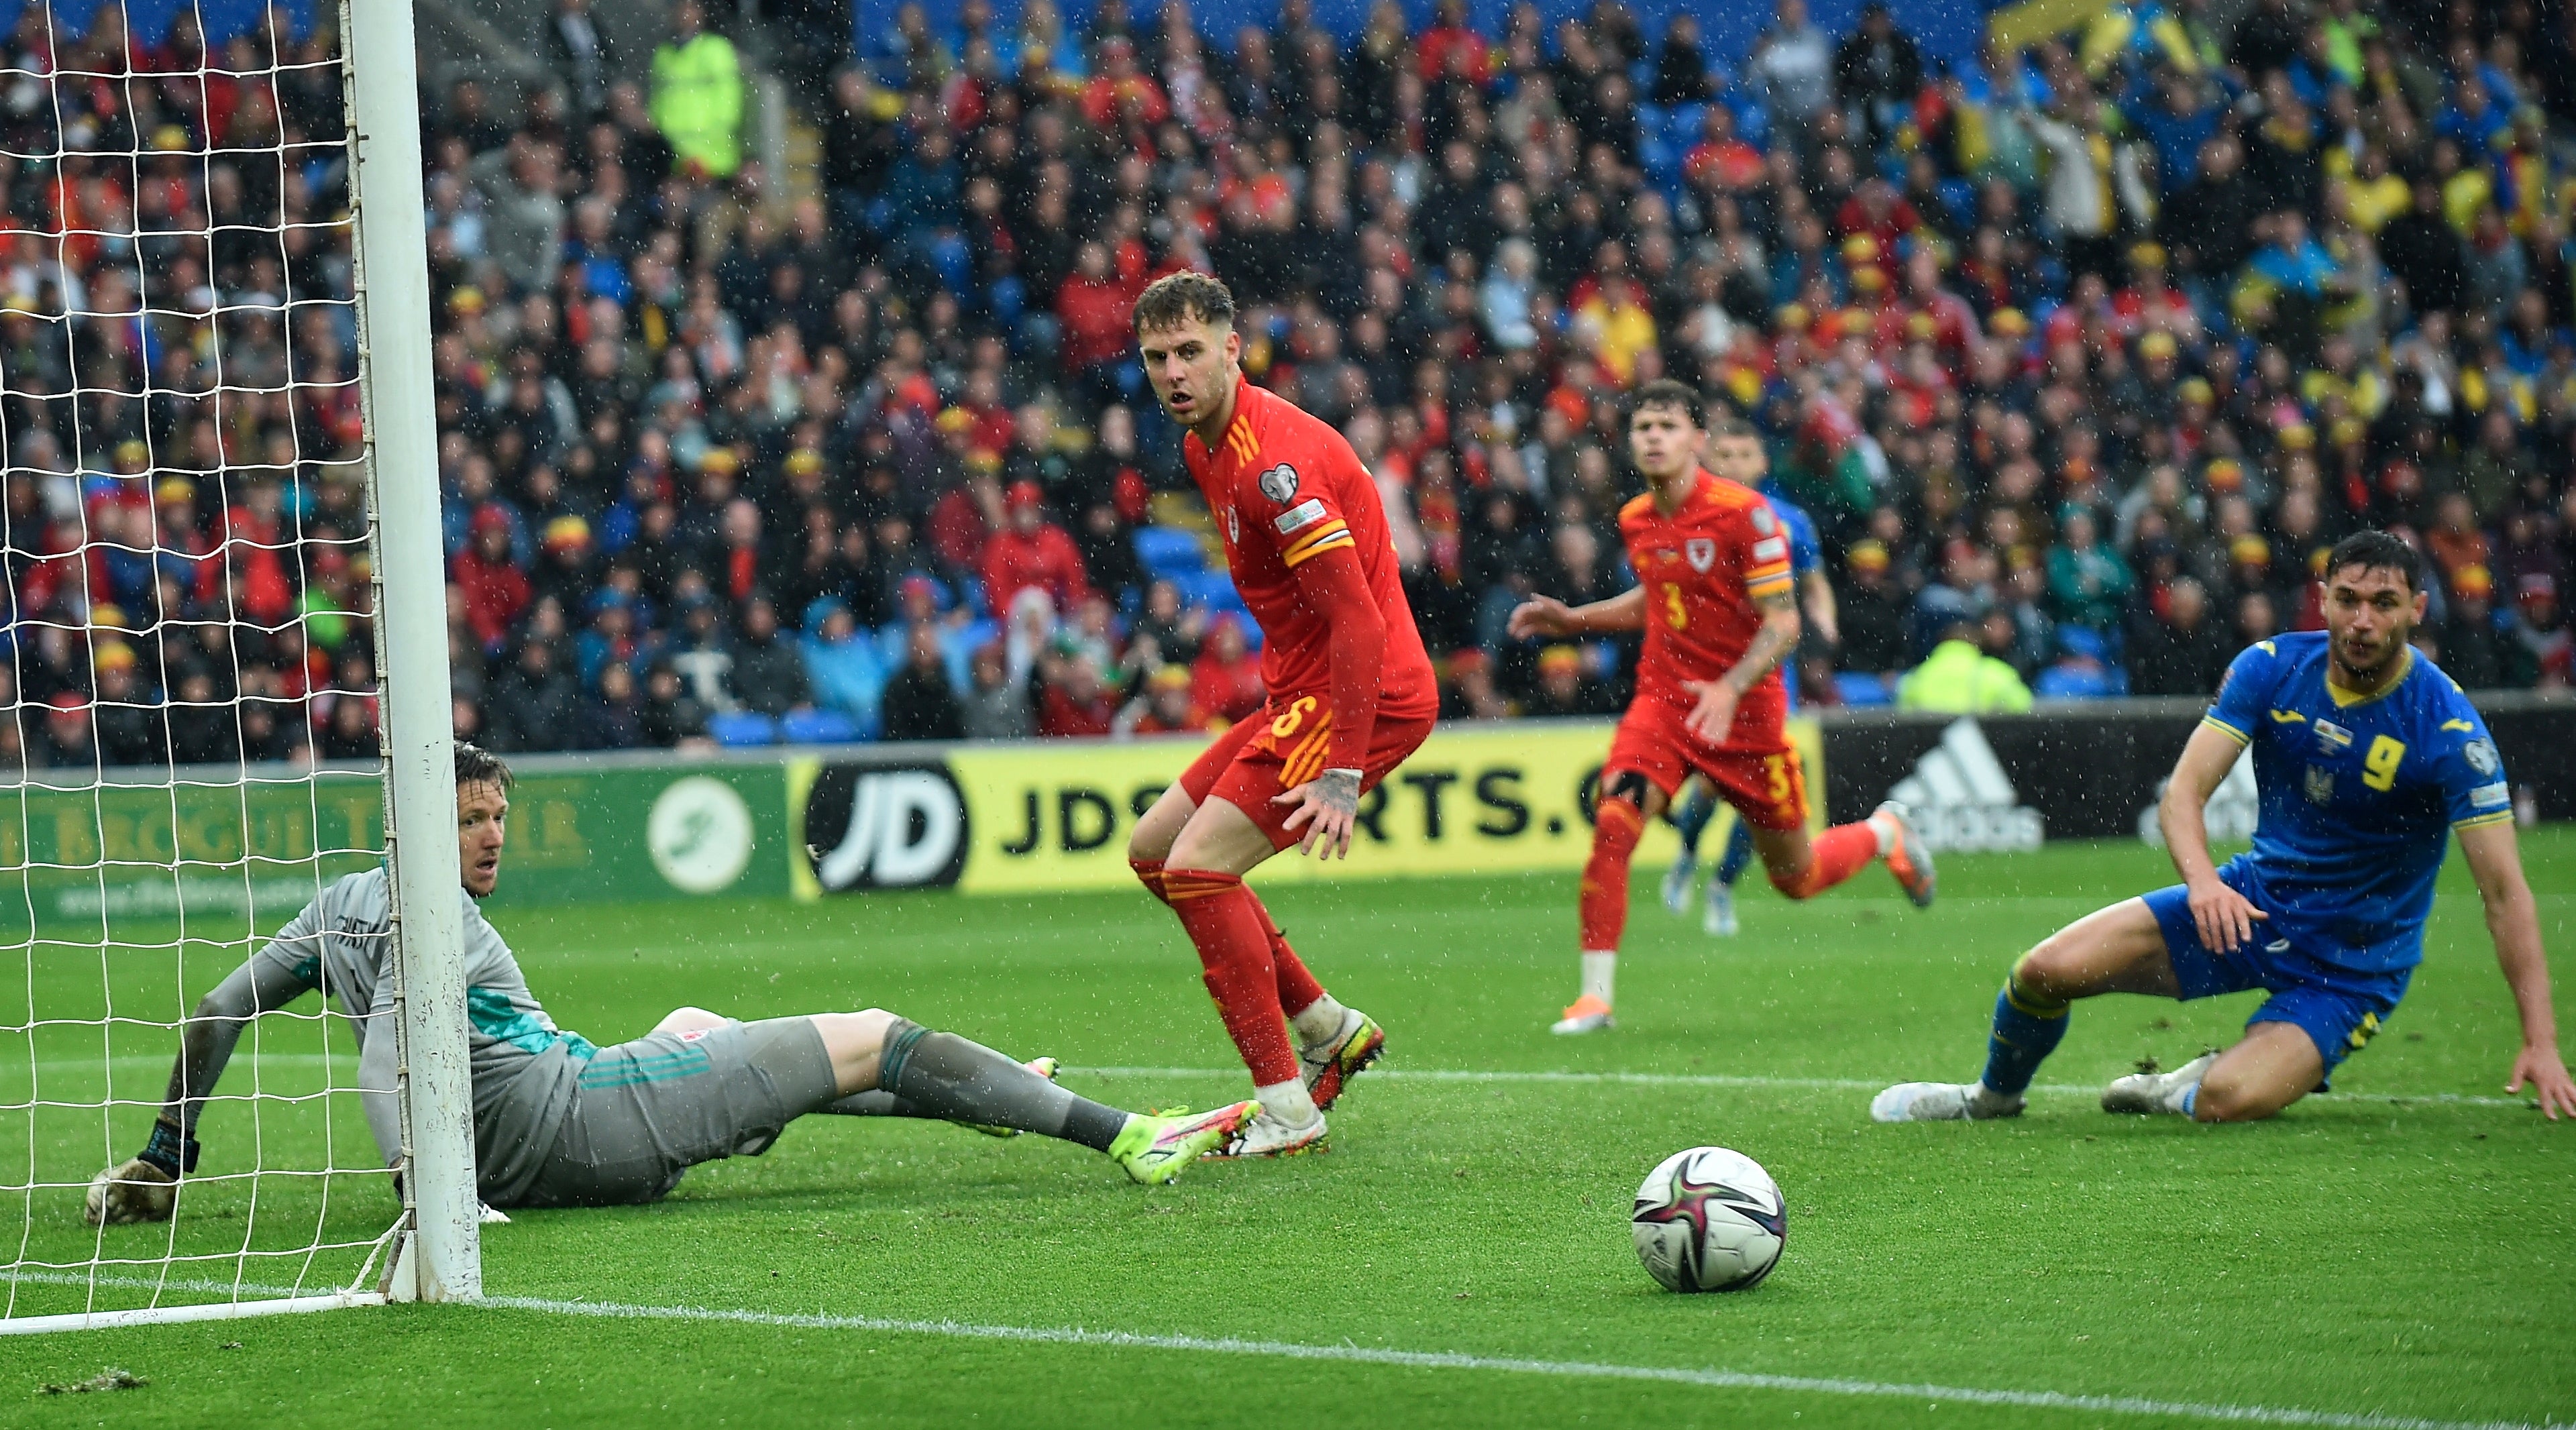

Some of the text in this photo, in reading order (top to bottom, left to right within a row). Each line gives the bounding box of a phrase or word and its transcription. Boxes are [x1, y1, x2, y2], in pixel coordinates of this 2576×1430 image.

[1662, 582, 1688, 630] 3
[1271, 696, 1317, 738] 6
[1765, 755, 1790, 800] 3
[2361, 734, 2407, 793] 9
[818, 770, 961, 891] JD
[1907, 805, 2045, 853] didas
